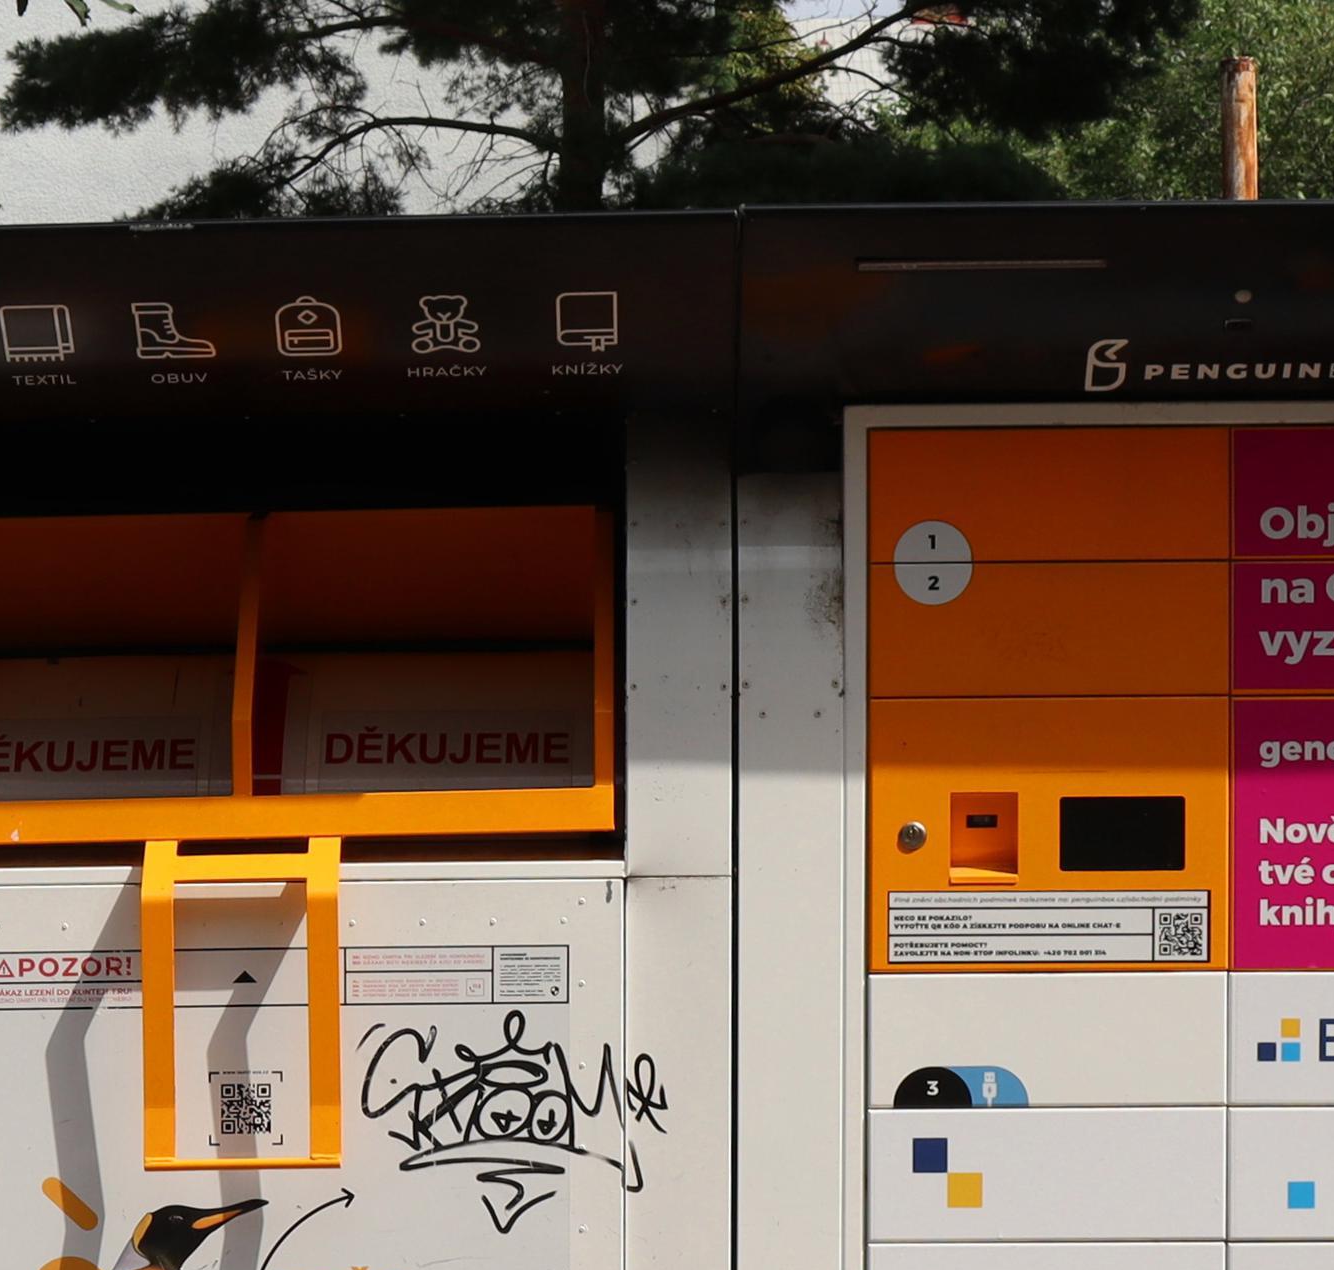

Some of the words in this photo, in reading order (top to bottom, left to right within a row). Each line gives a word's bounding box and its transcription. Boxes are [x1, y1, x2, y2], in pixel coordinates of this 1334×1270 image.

[282, 367, 343, 381] TAŠKY
[407, 363, 487, 379] HRAČKY
[551, 361, 624, 377] KNÍŽKY
[12, 374, 77, 386] TEXTIL
[151, 372, 208, 385] OBUV
[927, 534, 937, 550] 1
[926, 575, 940, 591] 2
[1260, 577, 1317, 605] na
[323, 724, 569, 766] DĚKUJEME
[1258, 856, 1315, 886] tvé
[19, 956, 132, 978] POZOR!
[24, 987, 56, 997] LEZENÍ
[57, 988, 70, 997] DO
[926, 1079, 939, 1096] 3
